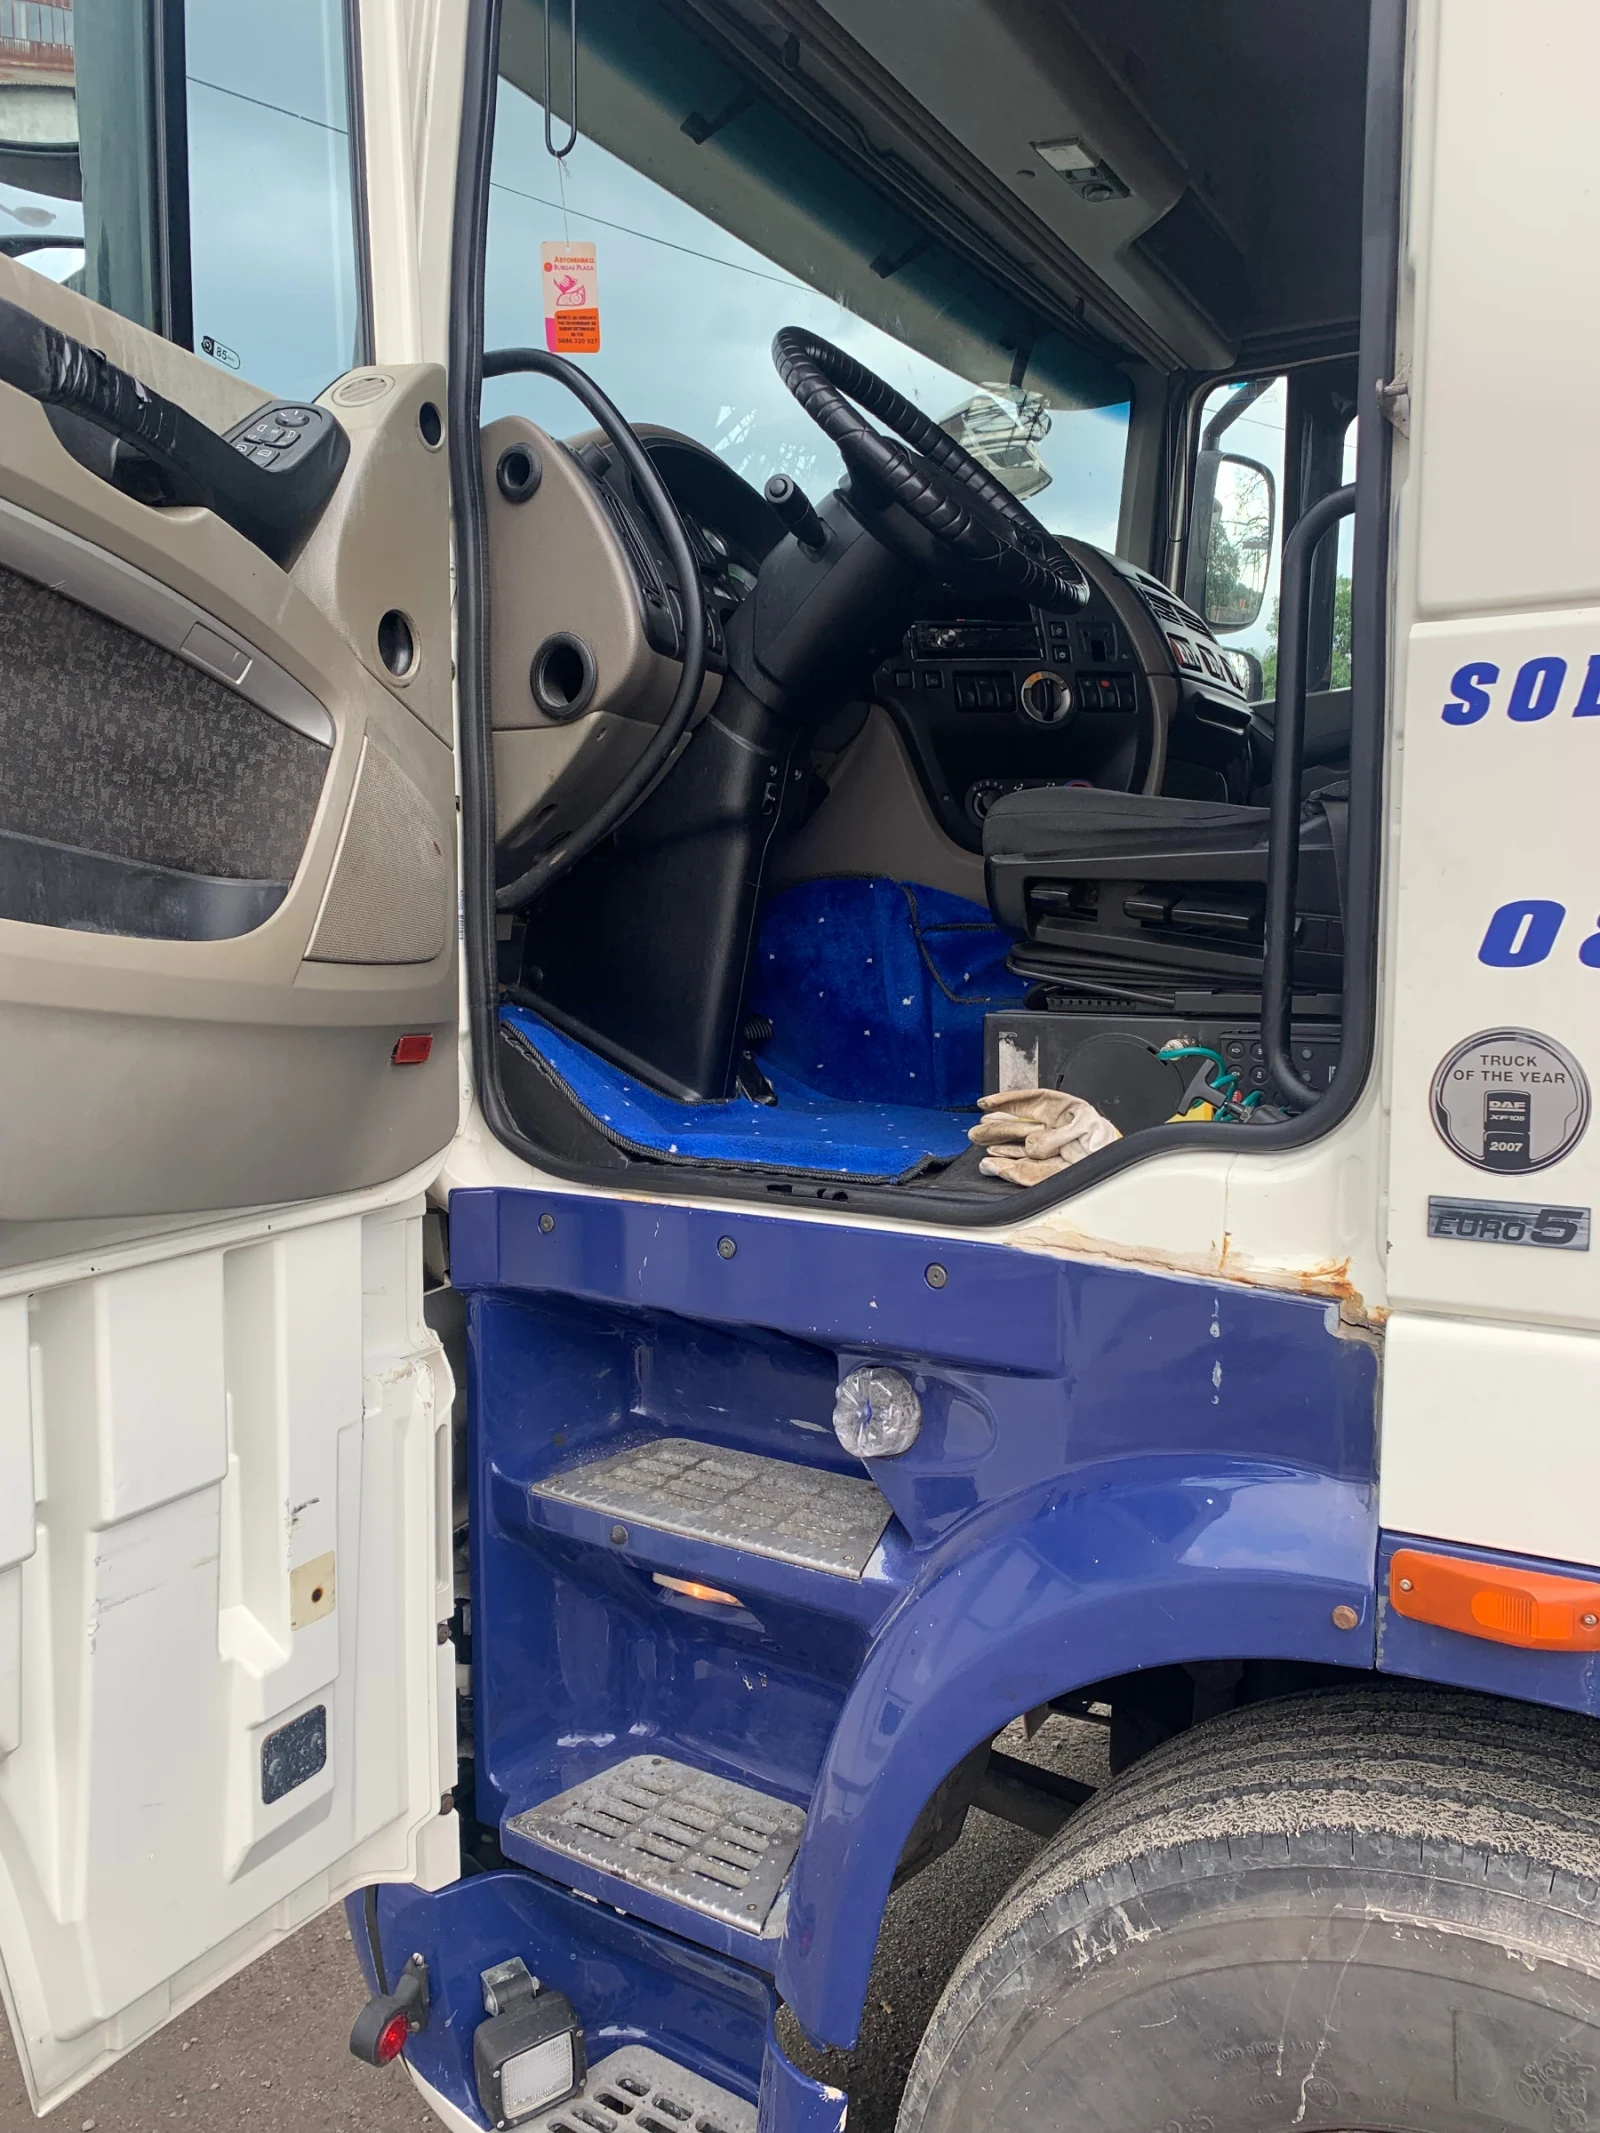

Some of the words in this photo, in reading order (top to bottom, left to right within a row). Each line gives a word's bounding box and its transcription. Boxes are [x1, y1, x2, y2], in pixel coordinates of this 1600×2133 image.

[1480, 1054, 1538, 1068] TRUCK
[1453, 1069, 1476, 1081] OF
[1481, 1070, 1514, 1082] THE
[1520, 1071, 1566, 1084] YEAR
[1489, 1100, 1526, 1110] DAF
[1489, 1141, 1523, 1152] 2007
